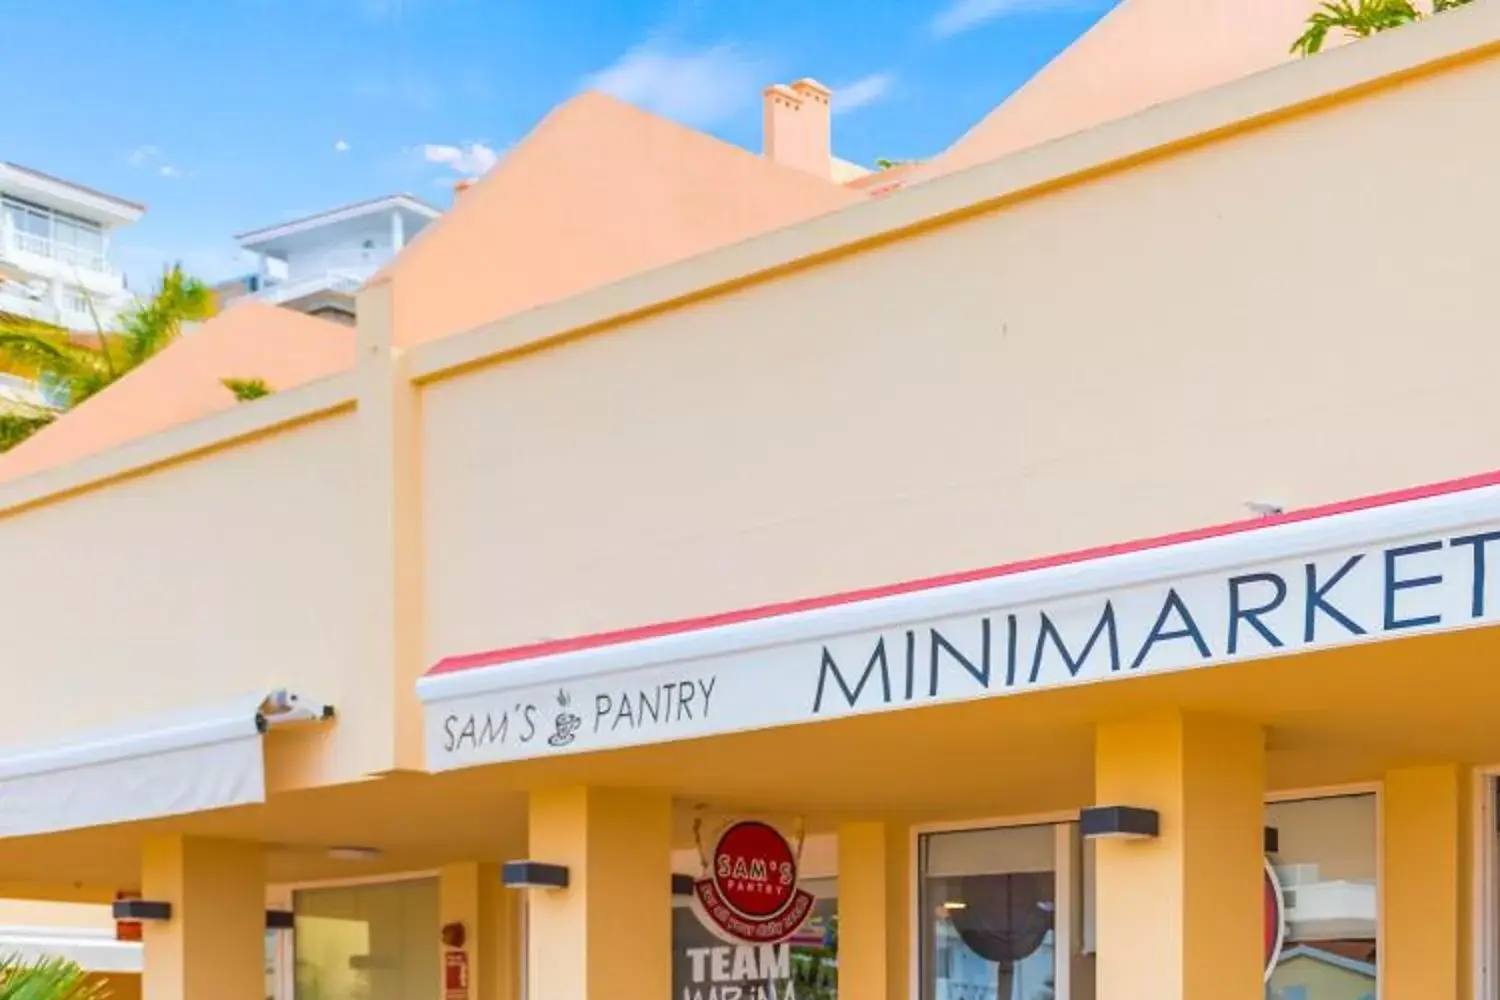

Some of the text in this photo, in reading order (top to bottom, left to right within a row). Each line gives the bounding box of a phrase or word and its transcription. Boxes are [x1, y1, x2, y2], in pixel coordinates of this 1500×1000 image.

[593, 676, 716, 732] PANTRY
[718, 854, 793, 885] SAM'S
[727, 880, 784, 895] PANTRY
[686, 944, 791, 982] TEAM
